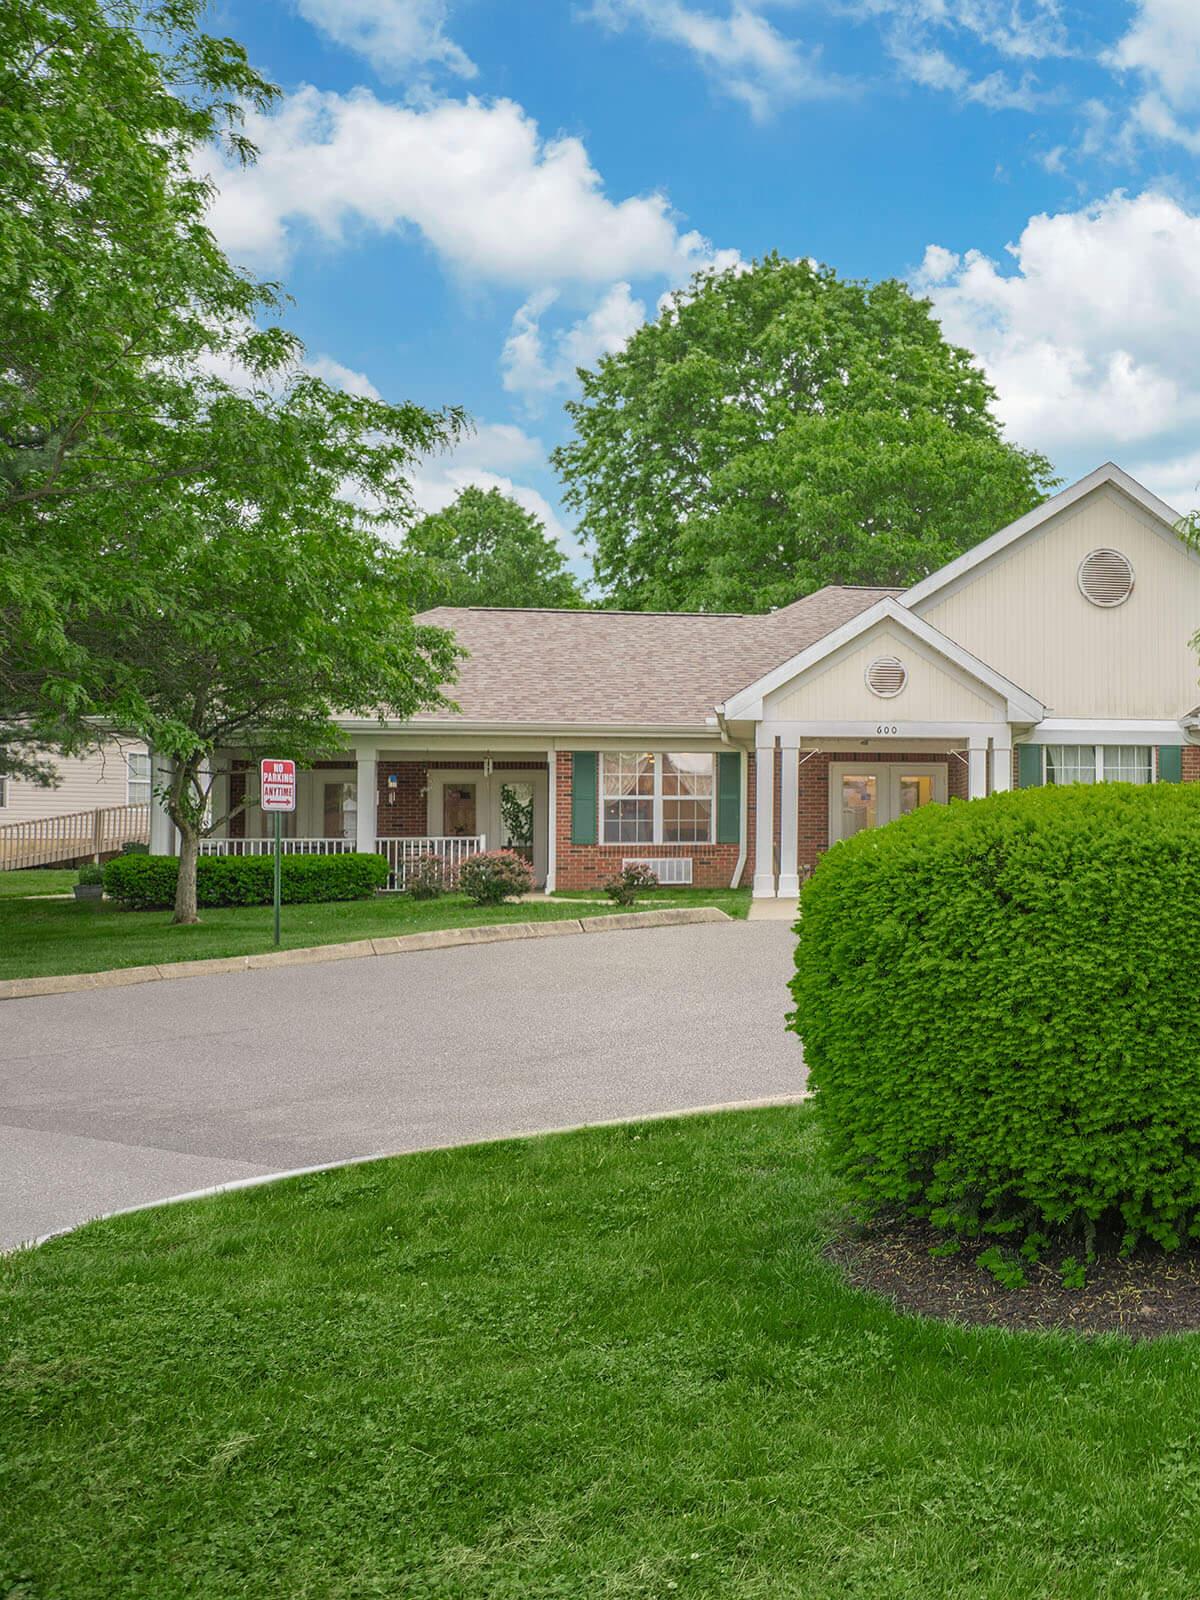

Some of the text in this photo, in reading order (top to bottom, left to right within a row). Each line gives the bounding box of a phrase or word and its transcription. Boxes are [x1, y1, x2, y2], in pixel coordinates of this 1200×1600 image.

[877, 726, 897, 734] 600
[273, 763, 284, 772] NO
[264, 772, 294, 782] PARKING
[264, 786, 292, 796] ANYTIME
